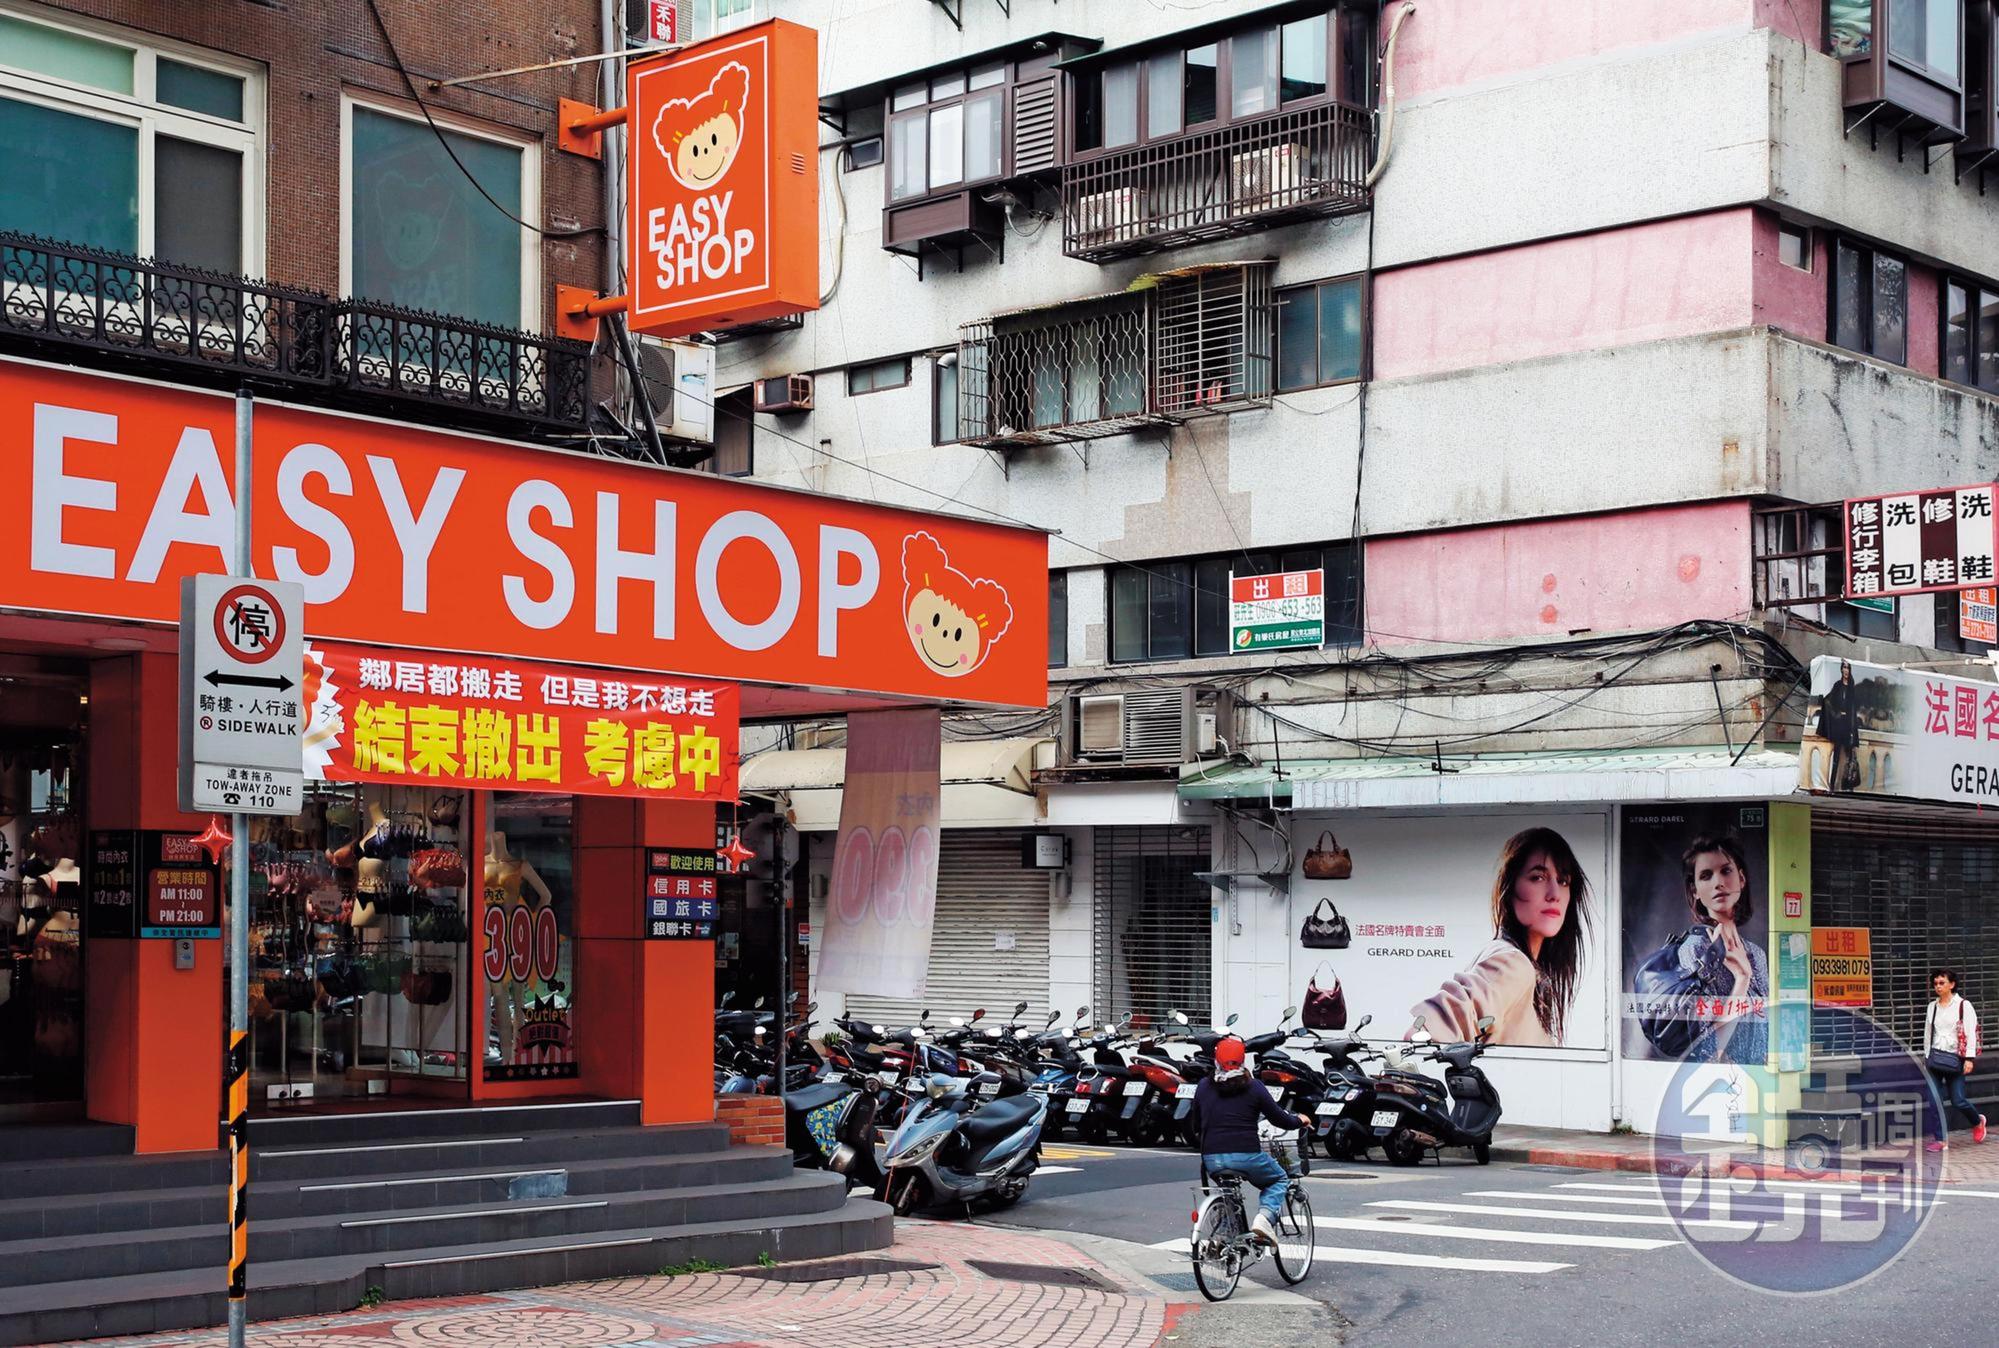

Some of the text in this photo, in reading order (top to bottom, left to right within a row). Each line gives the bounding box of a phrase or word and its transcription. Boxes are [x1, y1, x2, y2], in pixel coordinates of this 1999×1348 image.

[648, 190, 734, 252] EASY
[656, 228, 755, 290] SHOP
[31, 402, 881, 658] EASY SHOP
[1961, 493, 1993, 580] 洗鞋
[1851, 501, 1880, 594] 修行李箱
[1886, 502, 1917, 586] 洗包
[1922, 498, 1956, 584] 修鞋
[229, 602, 270, 648] 停
[359, 658, 716, 717] 鄰居都搬走 但是我不想走
[1925, 681, 1999, 741] 法國名
[218, 719, 297, 736] SIDEWALK
[352, 699, 721, 792] 結束撤出 考慮中
[227, 768, 273, 783] 違者拖吊
[206, 779, 292, 797] TOW-AWAY ZONE
[249, 795, 275, 808] 110
[670, 855, 715, 871] 歡迎使用
[156, 872, 207, 885] 營業時間
[654, 878, 713, 896] 信用卡
[160, 888, 203, 900] AM 11:00
[160, 910, 204, 922] PM 21:00
[653, 899, 712, 917] 國旅卡
[653, 921, 692, 936] 銀聯卡
[485, 904, 559, 982] 390
[1826, 931, 1856, 953] 出租
[1367, 947, 1454, 958] GERARD DAREL
[1813, 958, 1870, 976] 0933981079
[526, 1006, 566, 1022] Outlet
